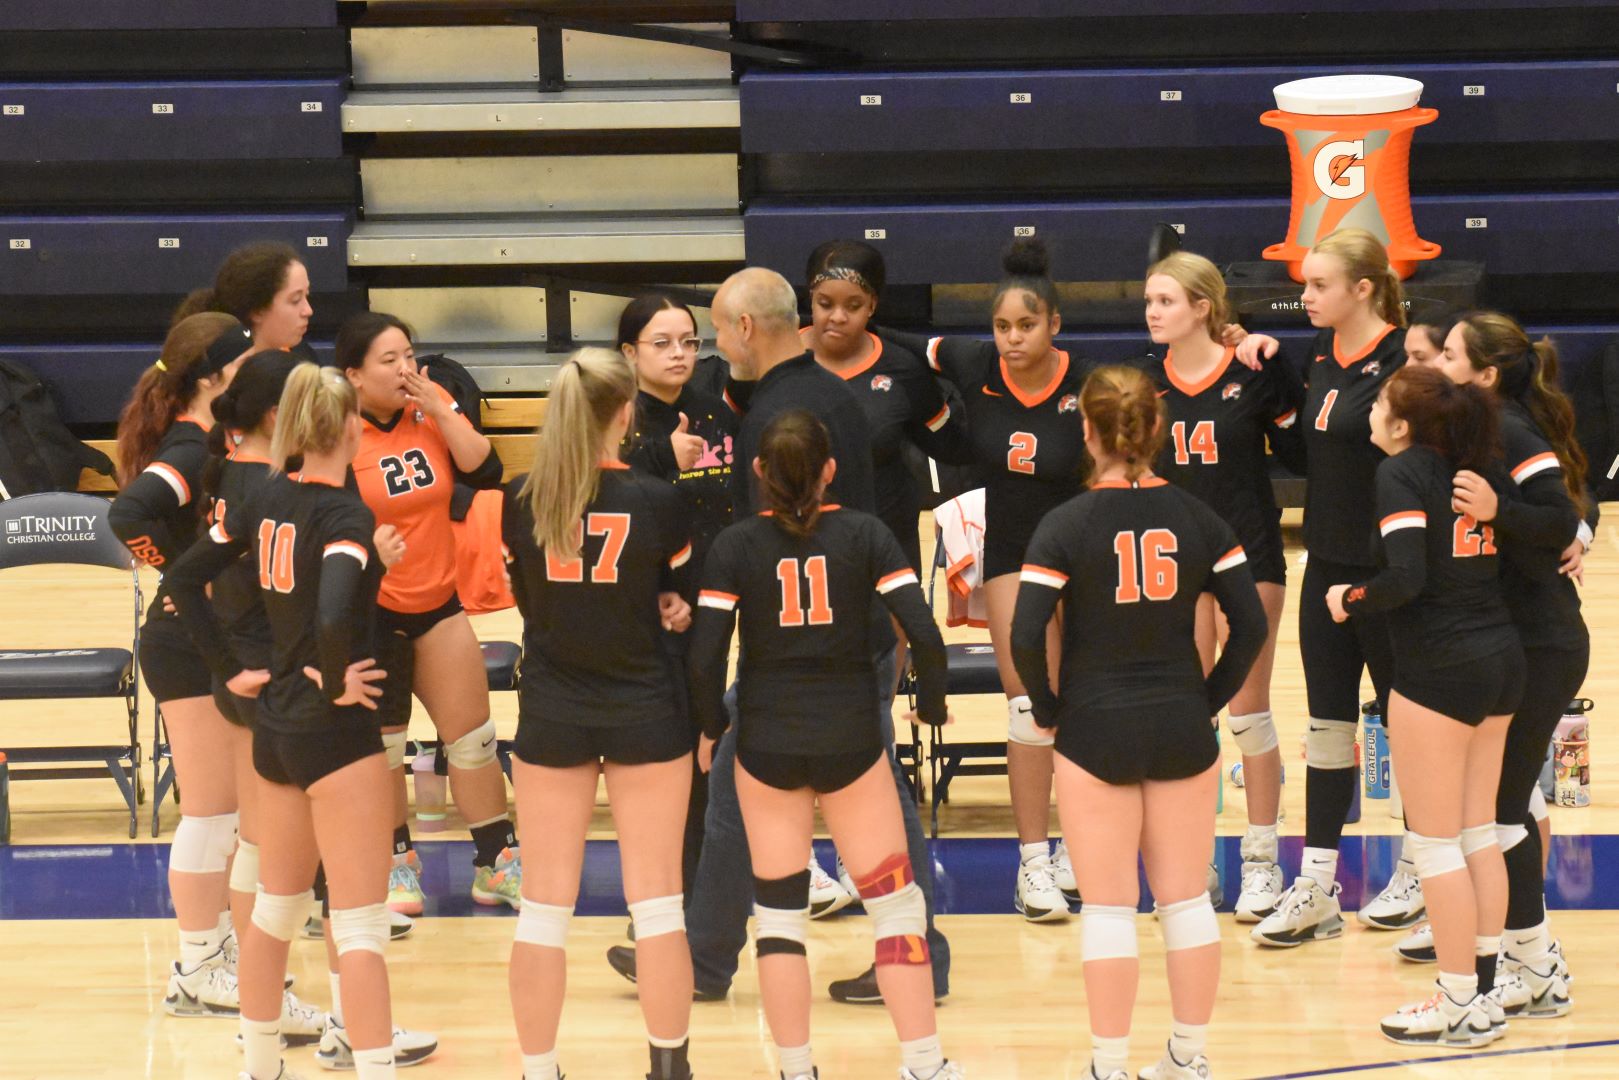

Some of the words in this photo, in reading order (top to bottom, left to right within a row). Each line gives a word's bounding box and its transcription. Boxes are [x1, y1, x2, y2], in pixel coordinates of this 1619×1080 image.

[1313, 139, 1365, 200] G
[1271, 300, 1306, 310] athlet
[1315, 389, 1339, 431] 1
[1008, 431, 1038, 475] 2
[1172, 420, 1218, 465] 14
[379, 448, 436, 498] 23
[7, 534, 54, 544] CHRISTIAN
[56, 533, 96, 542] COLLEGE
[259, 518, 296, 593] 10
[776, 555, 833, 627] 11
[1114, 528, 1178, 604] 16
[1368, 728, 1376, 784] GRATEFUL
